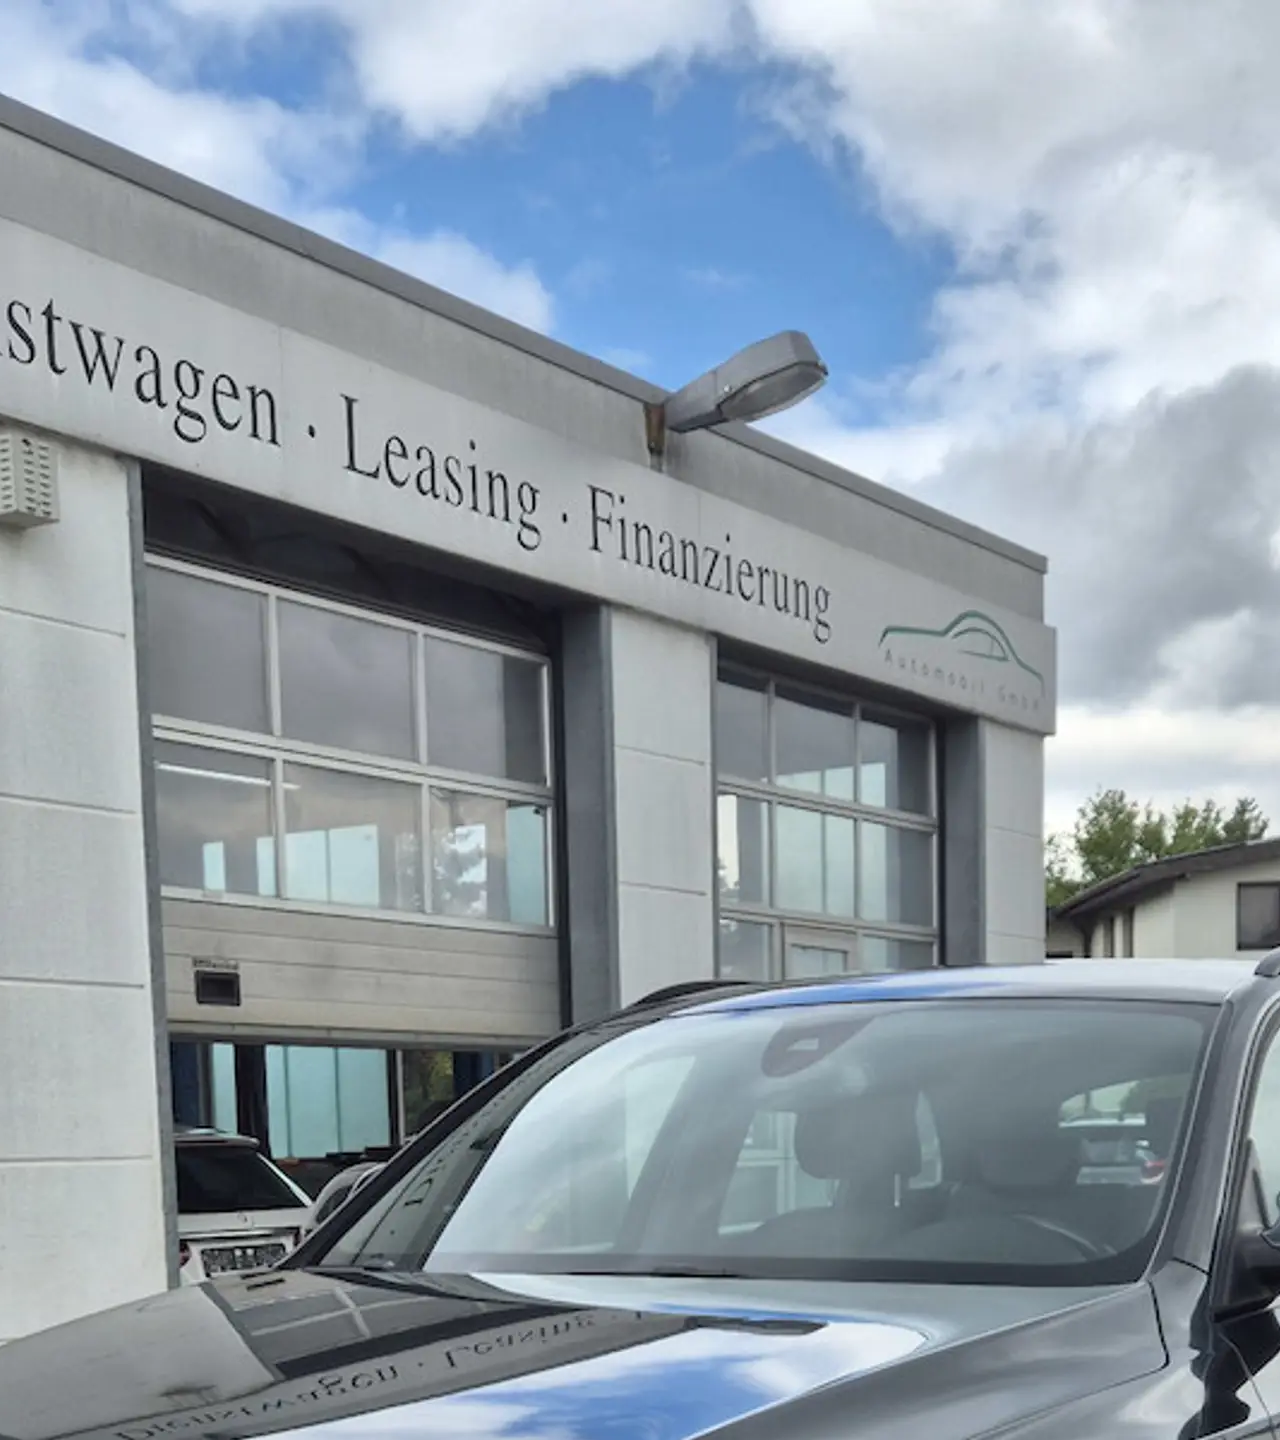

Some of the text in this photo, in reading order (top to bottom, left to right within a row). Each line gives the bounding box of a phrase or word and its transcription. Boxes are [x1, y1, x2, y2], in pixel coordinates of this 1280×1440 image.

[340, 394, 541, 551] Leasing
[587, 485, 833, 643] Finanzierung
[883, 648, 986, 695] Automobil
